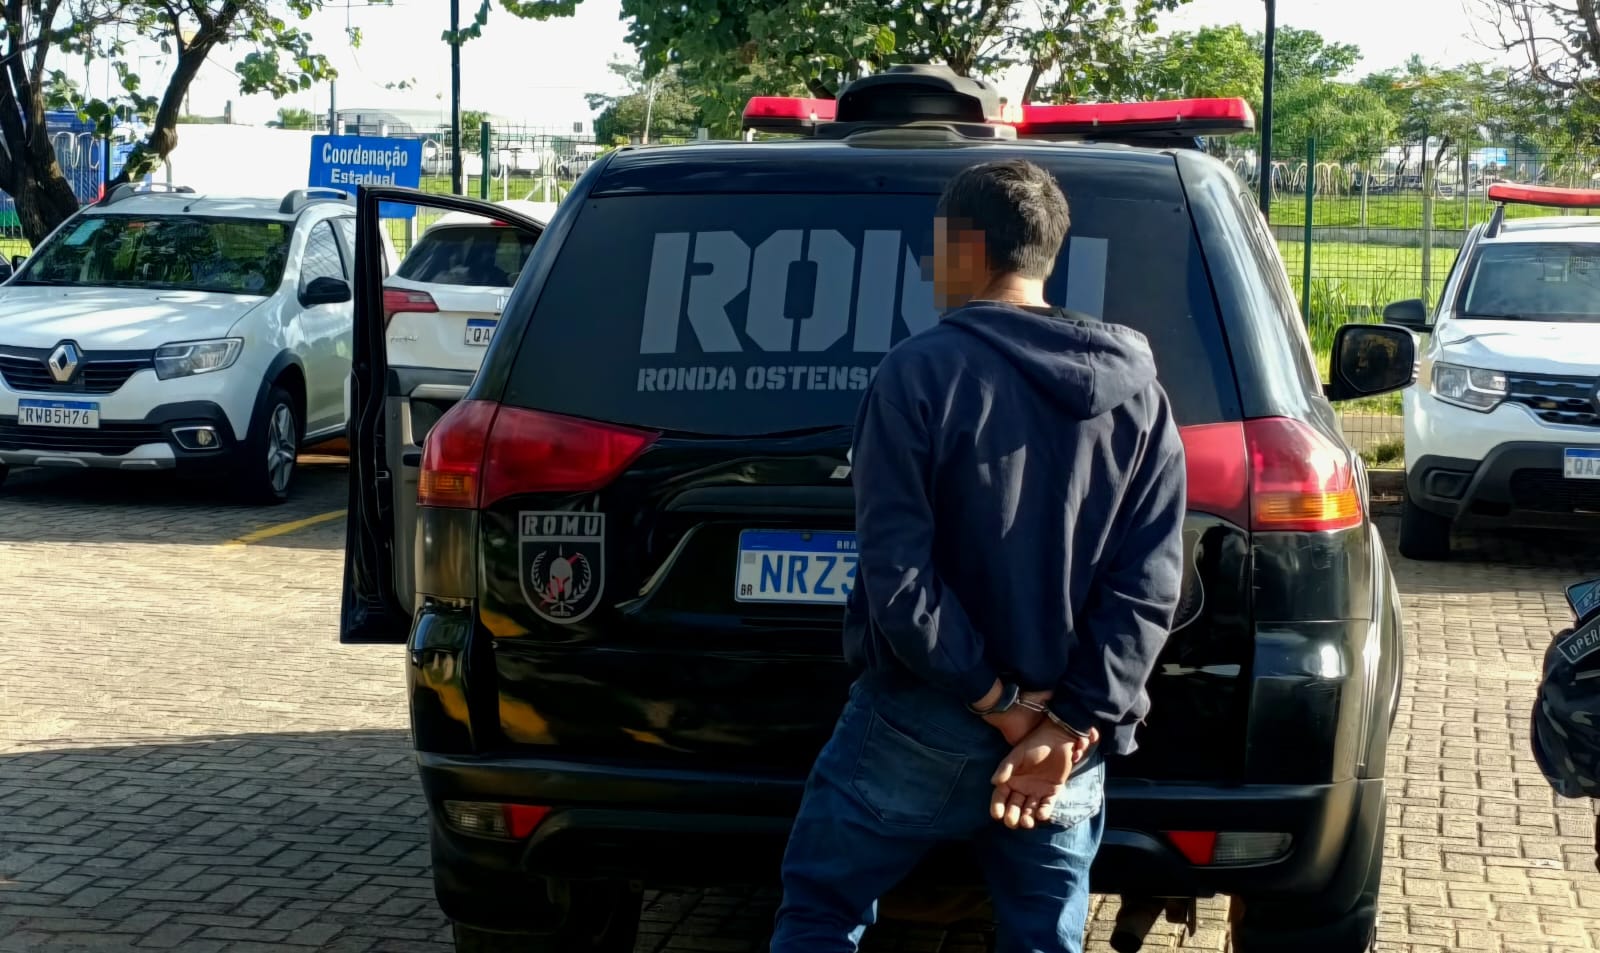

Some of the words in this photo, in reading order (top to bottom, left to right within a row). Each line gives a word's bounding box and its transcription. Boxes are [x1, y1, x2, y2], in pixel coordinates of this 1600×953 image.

[323, 142, 408, 171] Coordenação
[331, 168, 396, 185] Estadual
[637, 367, 737, 392] RONDA
[26, 407, 89, 425] RWB5H76
[524, 515, 599, 536] ROMU
[741, 584, 753, 596] BR
[1569, 624, 1600, 656] OPER
